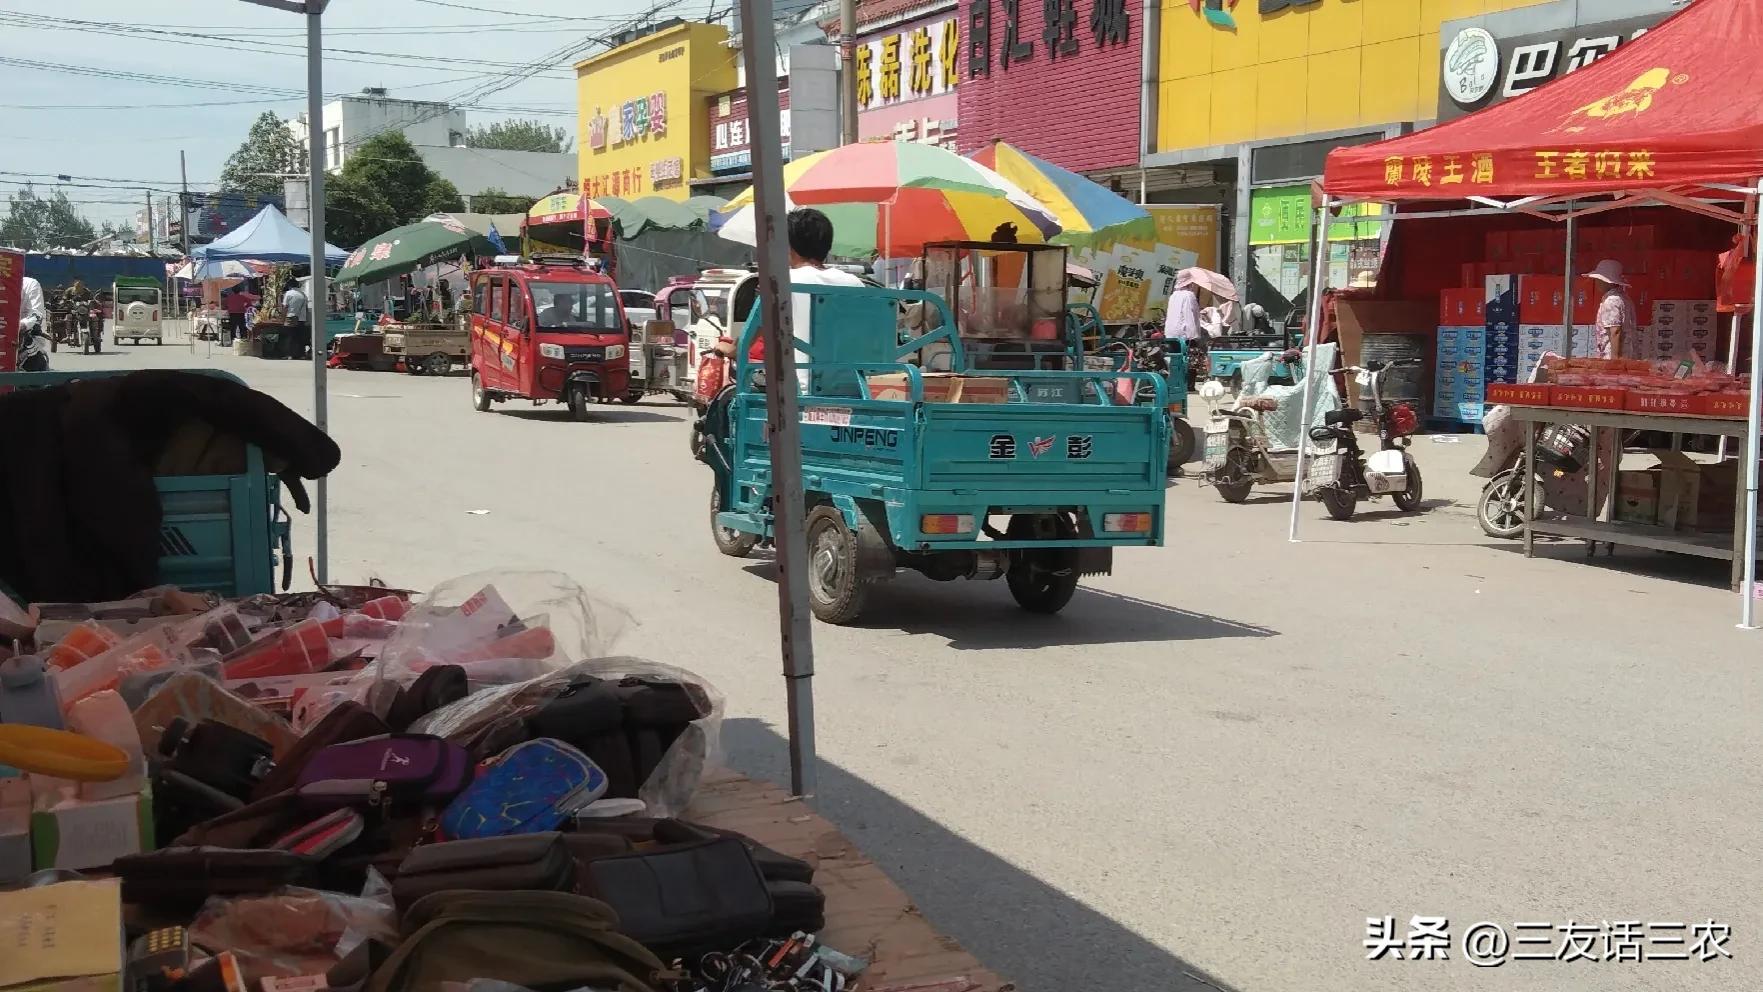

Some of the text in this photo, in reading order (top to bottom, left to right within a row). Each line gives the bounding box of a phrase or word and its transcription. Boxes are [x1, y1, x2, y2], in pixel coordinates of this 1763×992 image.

[1503, 28, 1648, 97] 巴尔
[831, 426, 898, 448] JINPENG
[989, 434, 1093, 460] 金 彭
